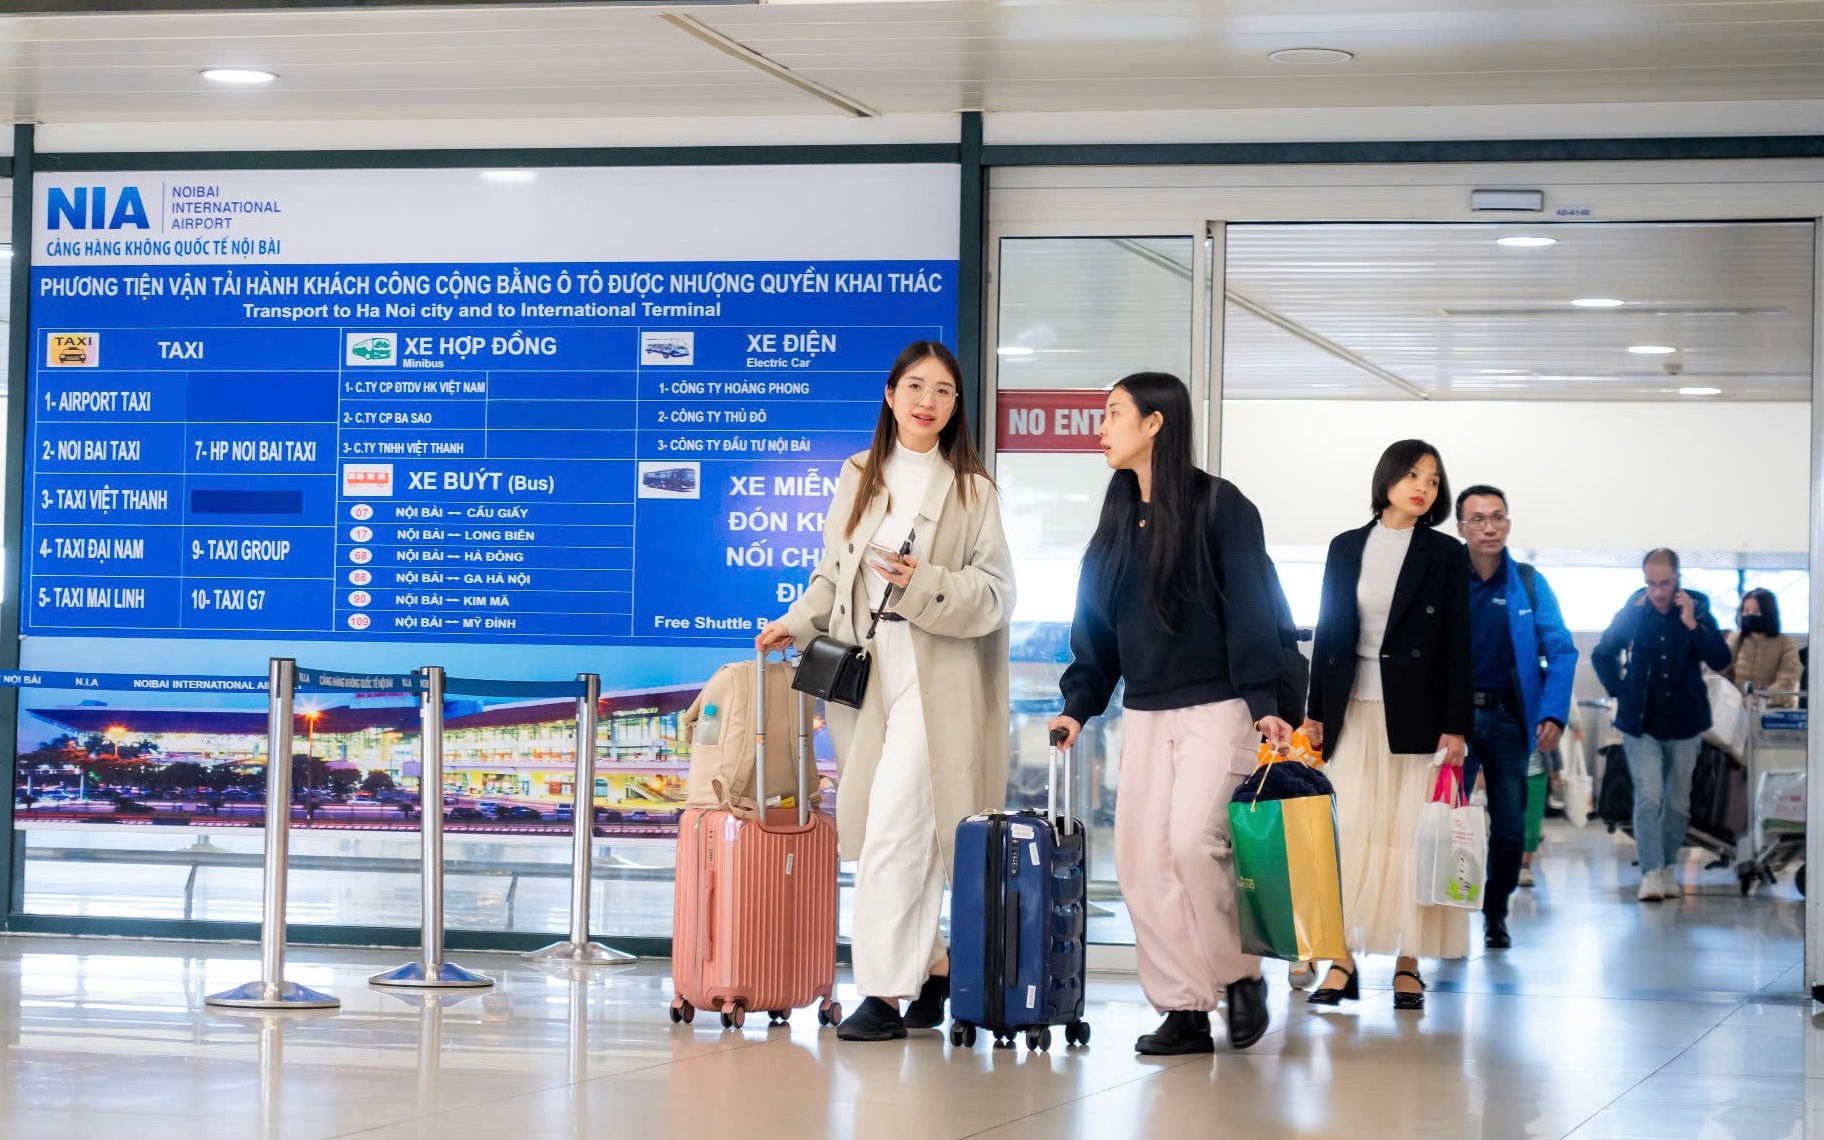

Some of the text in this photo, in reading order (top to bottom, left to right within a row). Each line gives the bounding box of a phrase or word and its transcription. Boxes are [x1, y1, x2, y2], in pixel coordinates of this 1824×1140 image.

[172, 186, 219, 198] NOIBAI
[47, 187, 150, 230] NIA
[172, 201, 282, 214] INTERNATIONAL
[171, 217, 233, 230] AIRPORT
[46, 235, 281, 259] CẢNG HÀNG KHÔNG QUỐC TẾ NỘI BÀI
[41, 266, 942, 300] PHƯƠNG TIỆN VẬN TẢI HÀNH KHÁCH CÔNG CỘNG BẰNG Ô TÔ ĐƯỢC NHƯỢNG QUYỀN KHAI THÁC
[243, 302, 720, 322] Transport to Ha Noi city and to International Terminal
[54, 337, 92, 346] TAXI
[404, 330, 557, 360] XE HỢP ĐỒNG
[746, 330, 837, 357] XE ĐIỆN
[158, 341, 204, 359] TAXI
[403, 359, 445, 368] Minibus
[747, 358, 811, 368] Electric Car
[355, 380, 485, 395] C.TY CP ĐTDV HK VIỆT NAM
[671, 379, 810, 394] CÔNG TY HOÀNG PHONG
[45, 391, 151, 411] 1- AIRPORT TAXI
[355, 413, 433, 424] C.TY CP BA SAO
[671, 408, 767, 422] CÔNG TY THỦ ĐÔ
[1008, 408, 1105, 436] NO ENT
[43, 440, 141, 461] 2- NOI BAI TAXI
[195, 441, 317, 461] 7- HP NOI BAI TAXI
[354, 440, 464, 456] C.TY TNHH VIỆT THANH
[658, 436, 811, 454] 3- CÔNG TY ĐẦU TƯ NỘI BÀI
[408, 468, 555, 495] XE BUÝT (Bus)
[730, 469, 839, 497] XE MIỄN
[42, 485, 168, 514] 3- TAXI VIỆT THANH
[356, 508, 368, 518] 07
[396, 504, 529, 519] NỘI BÀI CẦU GIẤY
[728, 507, 788, 532] ĐÓN
[356, 530, 368, 539] 17
[397, 527, 535, 541] NỘI BÀI LONG BIÊN
[40, 539, 144, 563] 4- TAXI ĐẠI NAM
[192, 540, 291, 561] 9- TAXI GROUP
[355, 551, 367, 561] 68
[397, 549, 524, 562] NỘI BÀI HÀ ĐÔNG
[727, 539, 773, 567] NỐI
[354, 573, 367, 582] 86
[396, 571, 531, 586] NỘI BÀI GA HÀ NỘI
[39, 588, 145, 609] 5- TAXI MAI LINH
[192, 589, 266, 610] 10- TAXI G7
[354, 594, 366, 604] 90
[396, 593, 510, 607] NỘI BÀI KIM MÃ
[351, 617, 369, 626] 109
[395, 615, 516, 629] NỘI BÀI MỸ ĐÌNH
[654, 615, 753, 630] Free Shuttle
[75, 677, 99, 687] N.I.A
[133, 680, 255, 690] NOIBAI INTERNATIONAL
